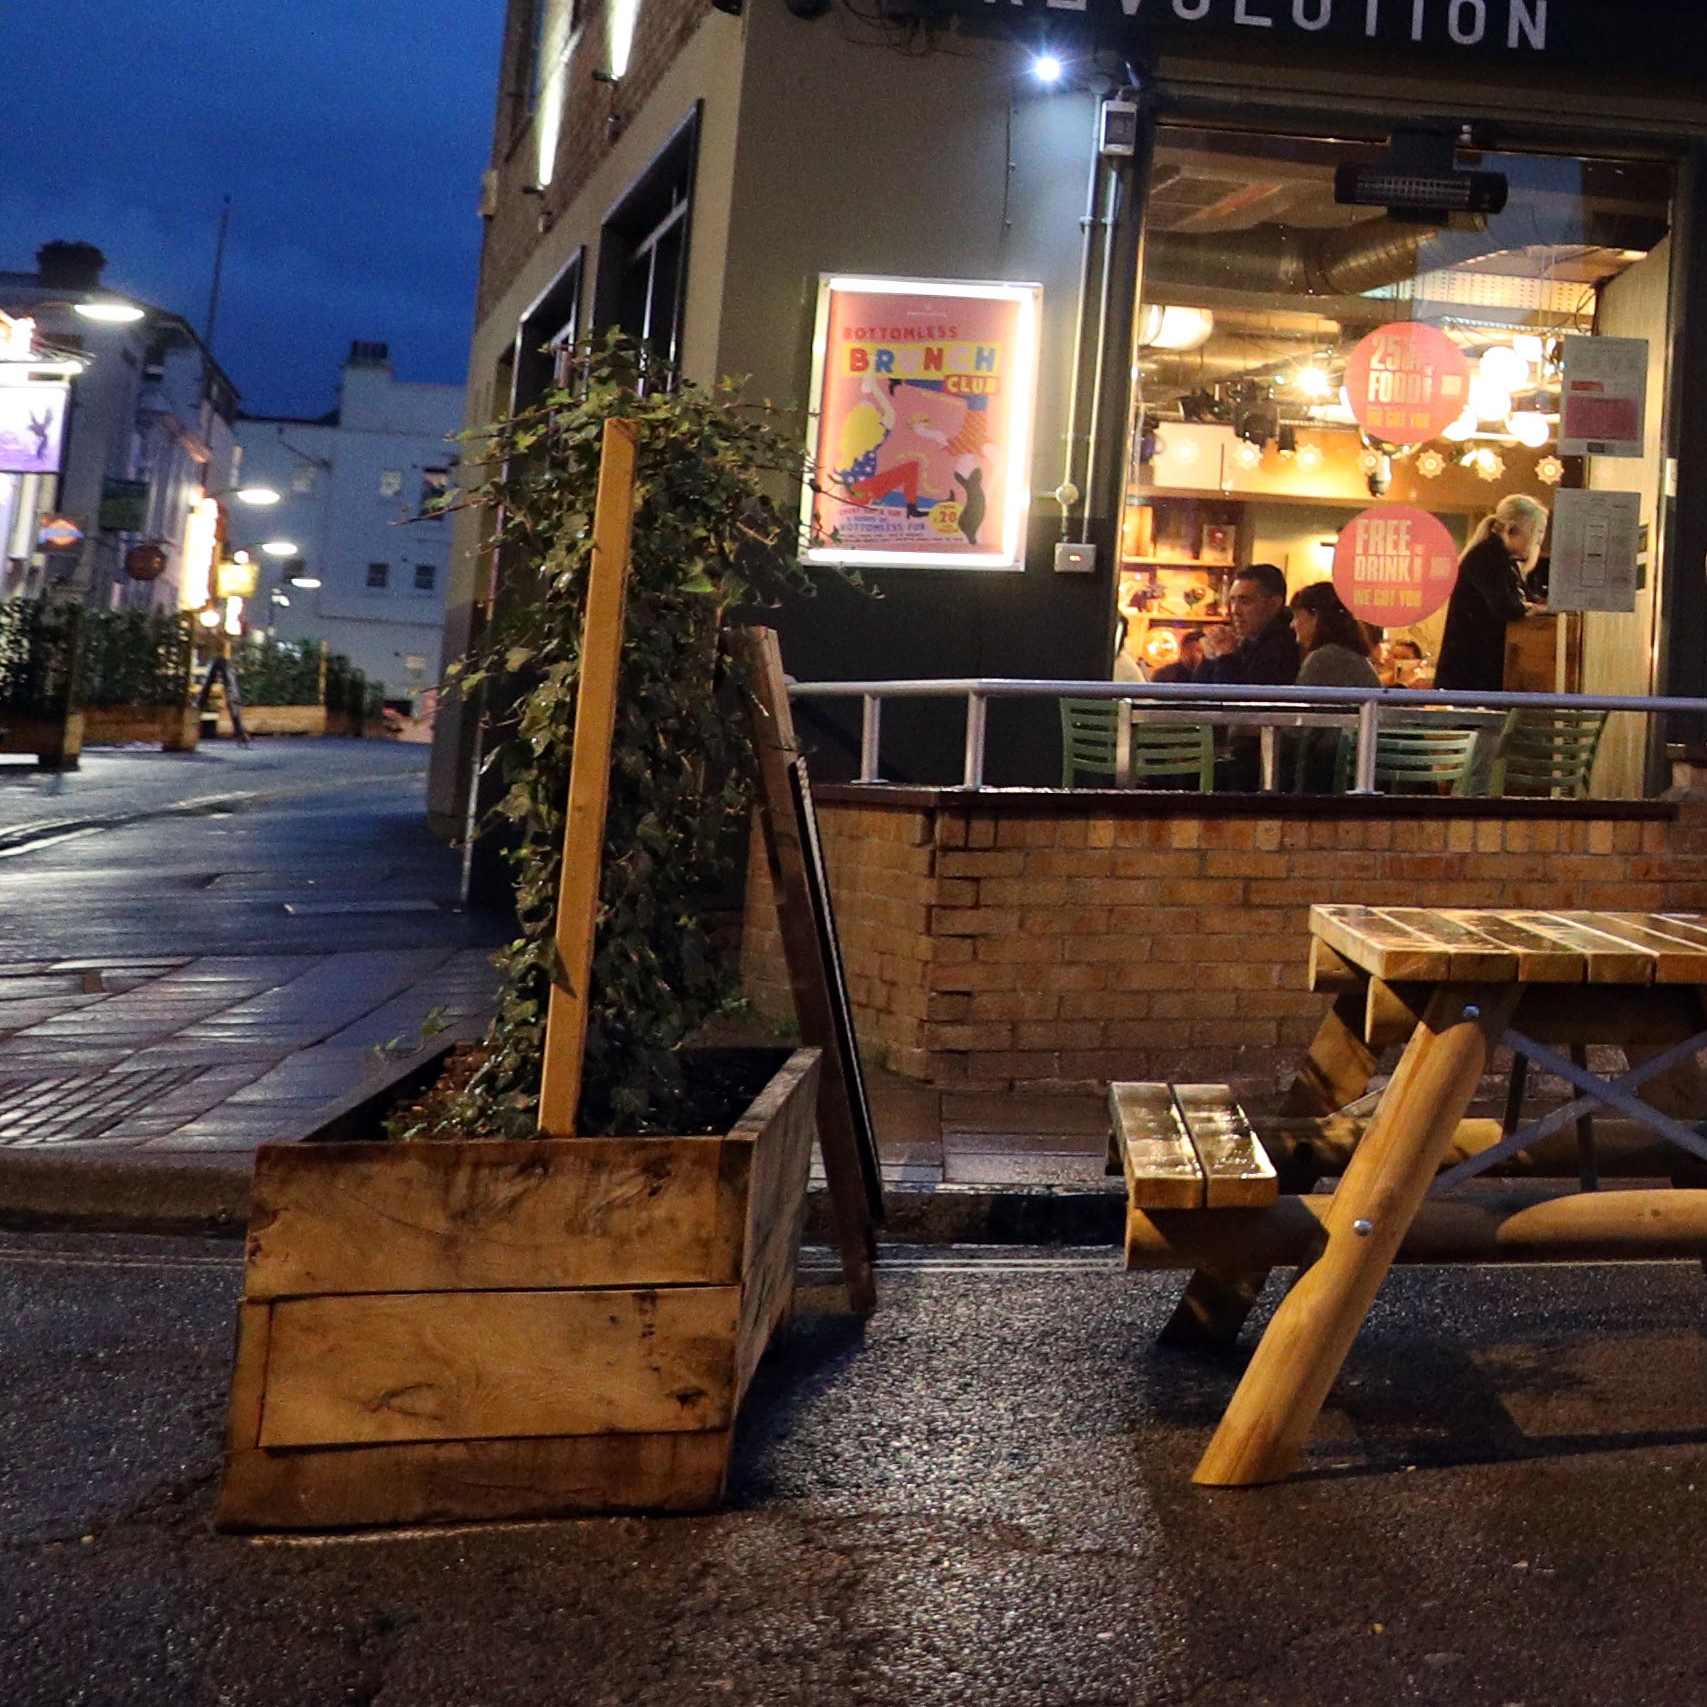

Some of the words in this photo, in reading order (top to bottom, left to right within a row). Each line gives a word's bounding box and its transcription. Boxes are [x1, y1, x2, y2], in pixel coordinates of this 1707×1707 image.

[843, 324, 959, 340] BOTTOMLESS
[850, 346, 996, 373] BRUNCH
[947, 375, 998, 394] CLUB
[1355, 519, 1412, 555] FREE
